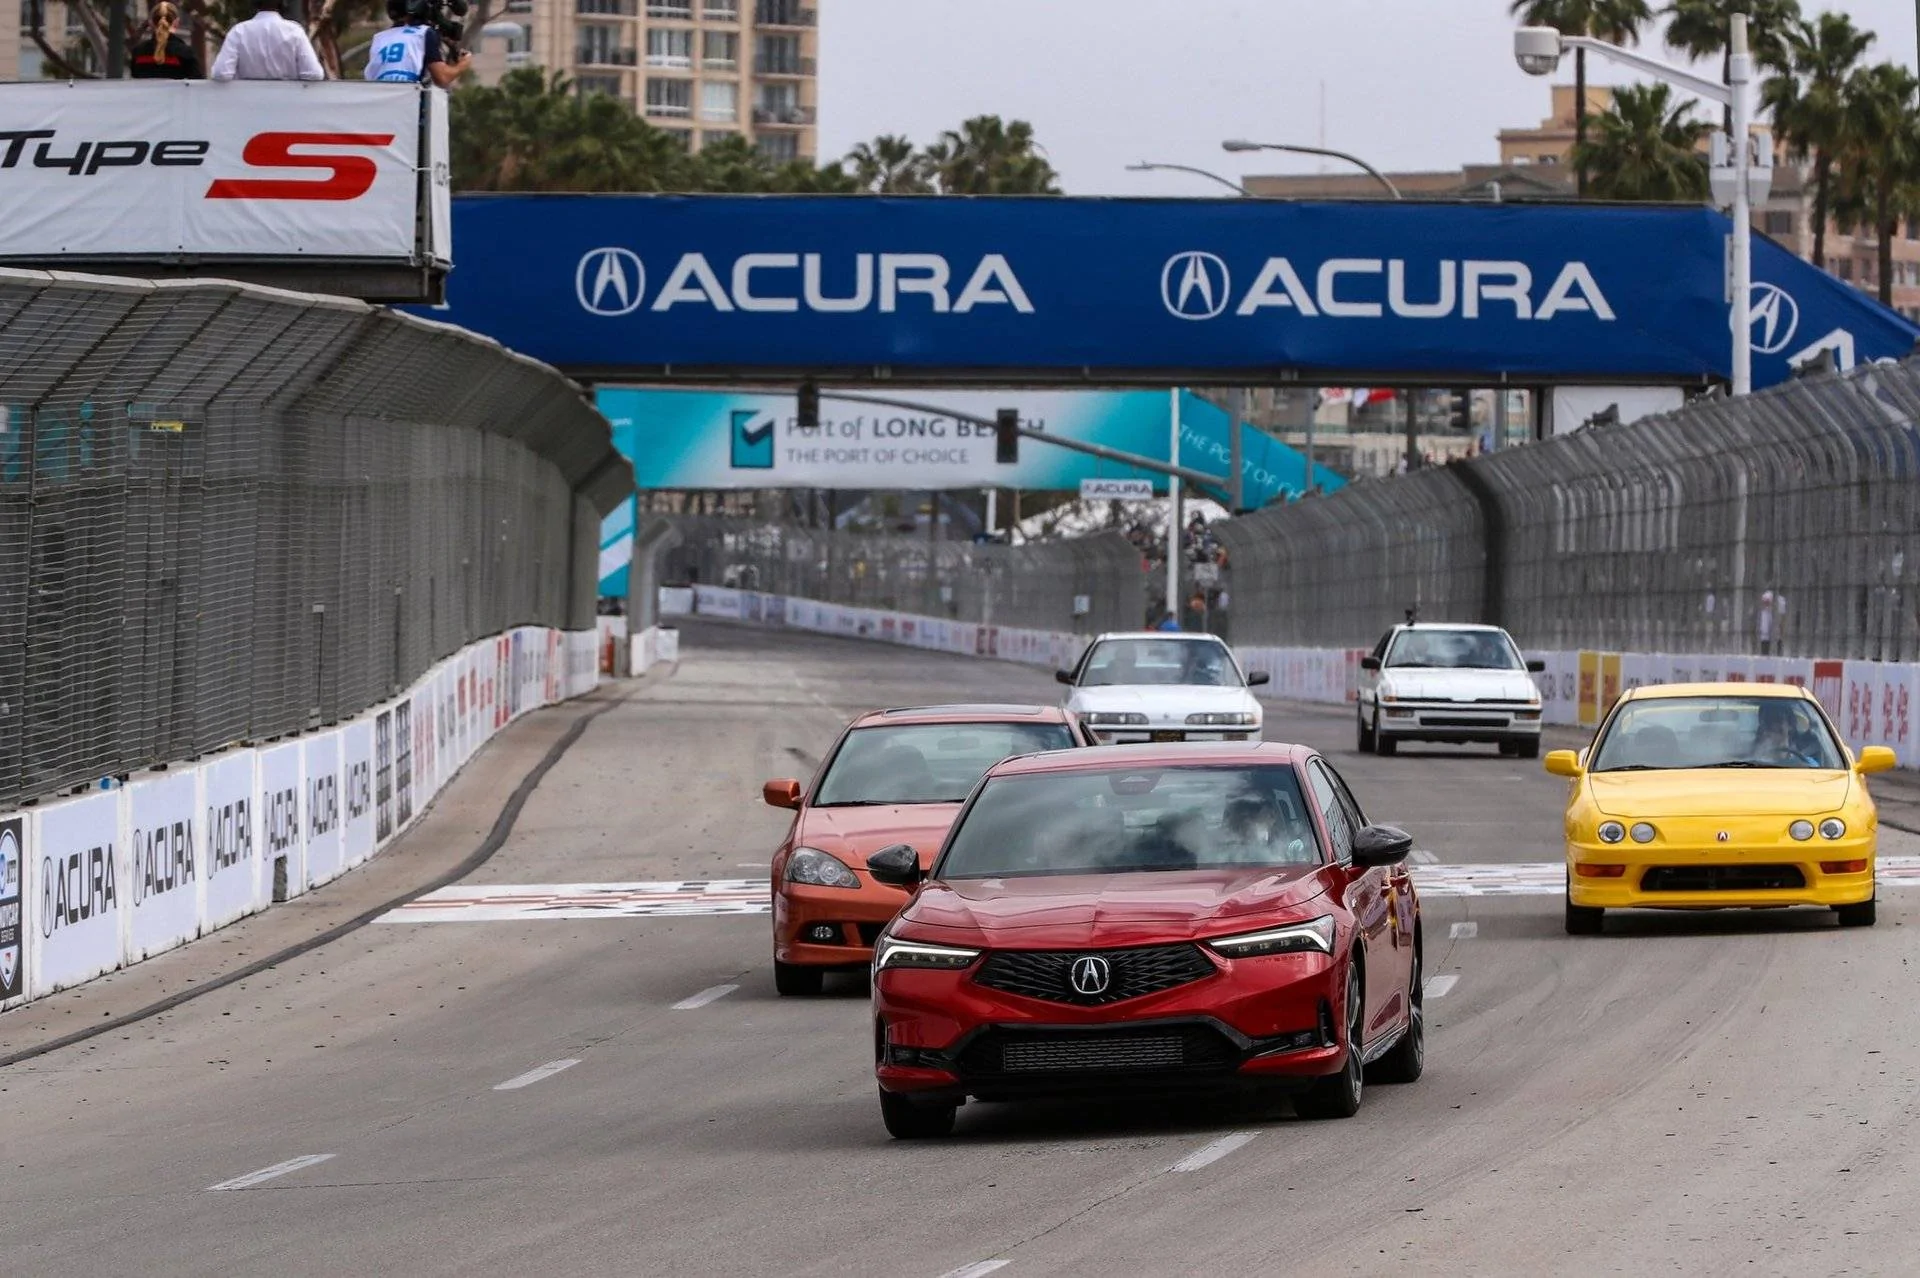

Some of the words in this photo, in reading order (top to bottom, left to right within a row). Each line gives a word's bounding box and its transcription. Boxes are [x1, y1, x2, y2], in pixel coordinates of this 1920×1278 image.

[379, 42, 405, 63] 19
[0, 129, 209, 176] Type
[204, 131, 396, 201] S
[652, 252, 1035, 314] ACURA
[1237, 256, 1615, 321] ACURA
[787, 448, 818, 464] THE
[824, 448, 868, 464] PORT
[874, 448, 897, 464] OF
[902, 448, 969, 464] CHOICE
[841, 416, 863, 440] of
[873, 417, 946, 438] LONG
[957, 417, 1045, 438] BEH
[1179, 423, 1205, 451] THE
[1208, 442, 1254, 475] POT
[1253, 467, 1277, 487] OF
[1094, 483, 1152, 494] ACURA
[143, 818, 196, 899] ACURA
[214, 797, 253, 873] ACURA
[54, 843, 118, 930] ACURA
